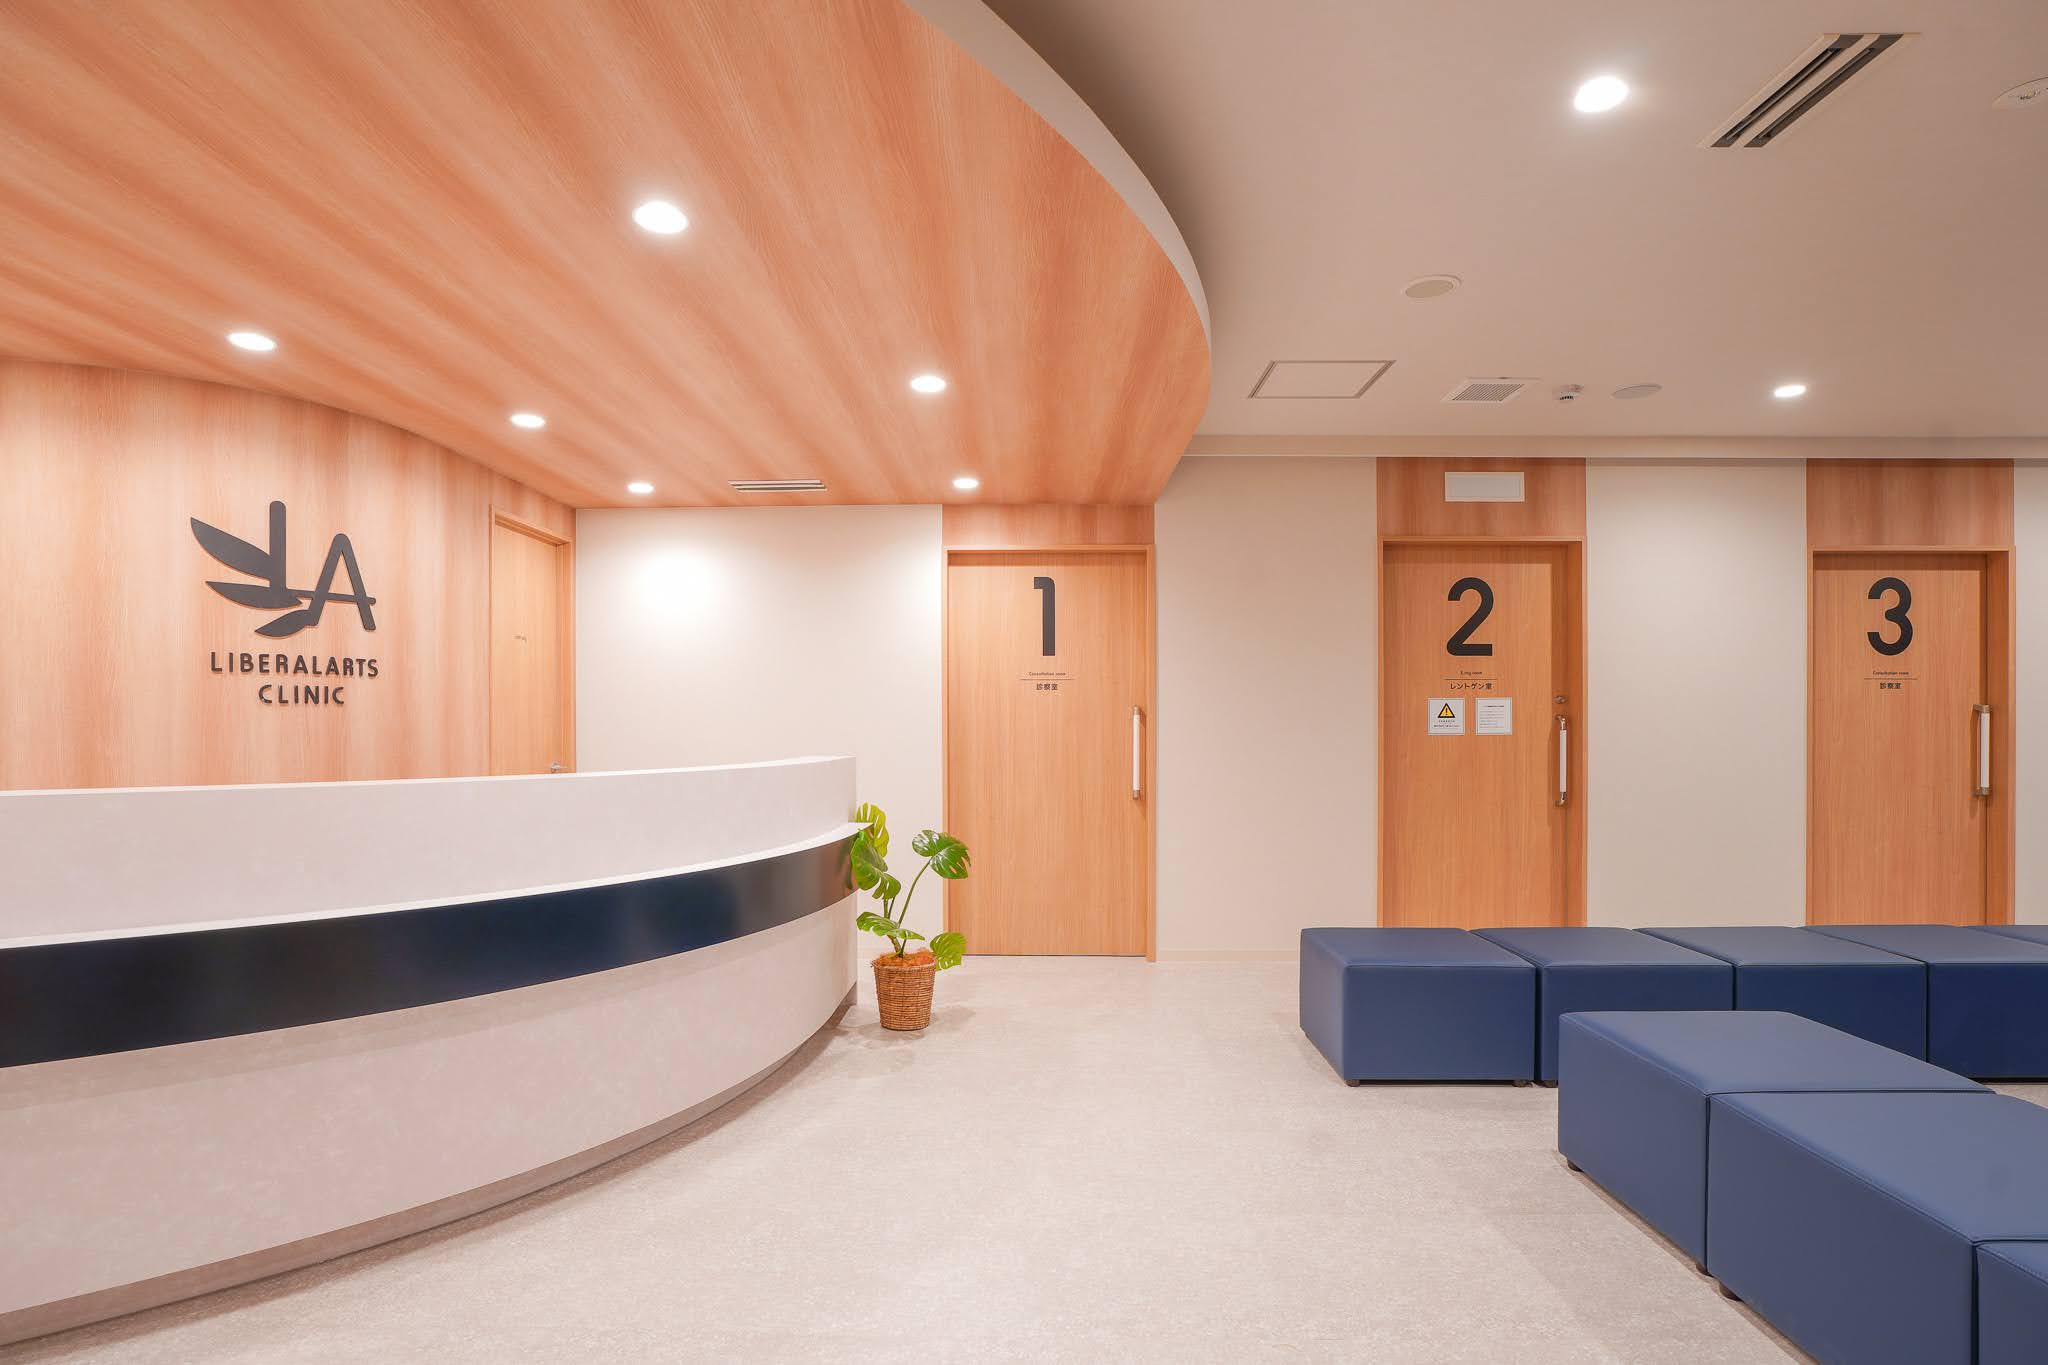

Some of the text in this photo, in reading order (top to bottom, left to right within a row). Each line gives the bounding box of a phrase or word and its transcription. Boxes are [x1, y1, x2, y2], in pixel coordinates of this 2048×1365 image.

[1033, 576, 1056, 657] 1
[1446, 576, 1495, 657] 2
[1866, 576, 1914, 656] 3
[210, 651, 379, 678] LIBERALARTS
[1450, 682, 1492, 690] レントゲン室
[258, 684, 345, 705] CLINIC
